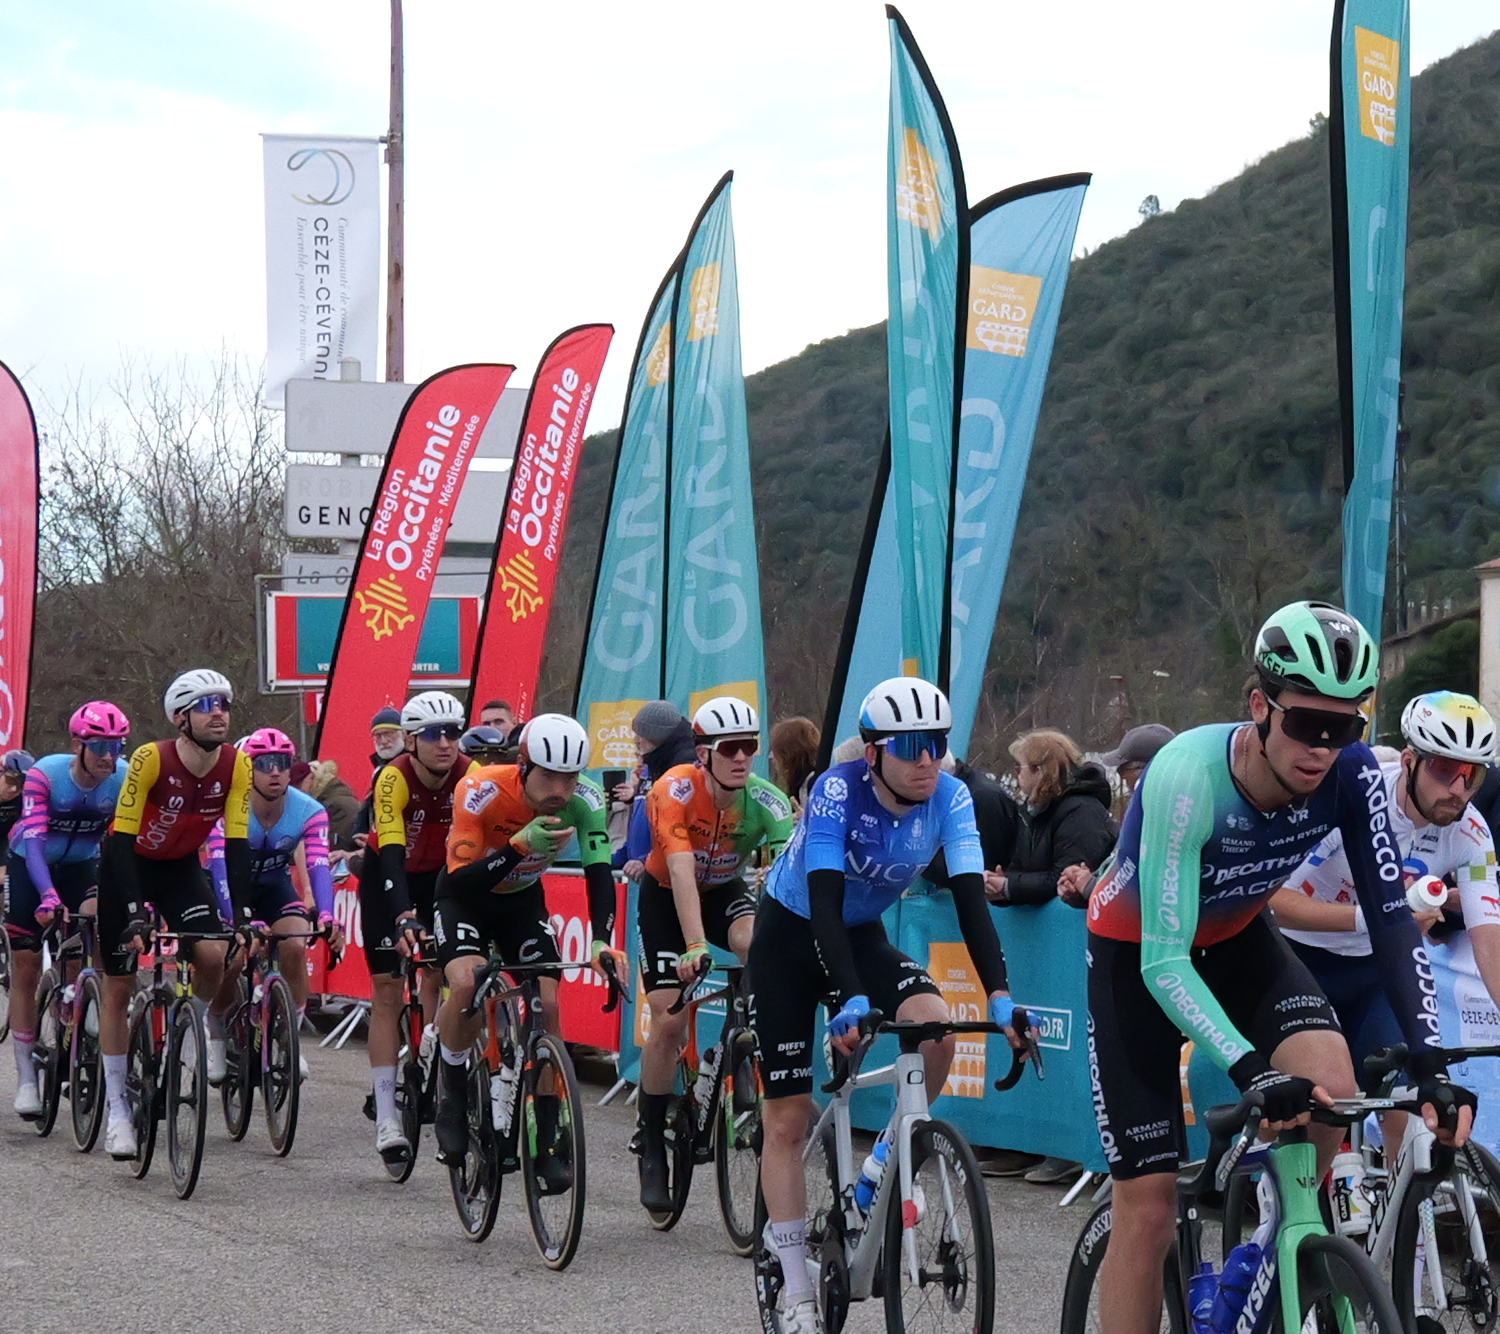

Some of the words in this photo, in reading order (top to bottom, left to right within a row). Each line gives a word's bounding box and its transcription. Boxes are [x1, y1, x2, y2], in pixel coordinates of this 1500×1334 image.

[972, 298, 1027, 323] GARD
[511, 432, 538, 509] Région
[520, 366, 580, 548] Occitanie
[543, 490, 566, 563] Pyrénées
[560, 380, 593, 481] Méditerranée
[365, 539, 383, 562] La
[375, 468, 406, 537] Région
[385, 404, 461, 571] Occitanie
[415, 514, 445, 581] Pyrénées
[440, 414, 481, 508] Méditerranée
[506, 513, 522, 535] La
[682, 380, 749, 655] GARD
[1259, 651, 1287, 677] YSEL
[597, 725, 637, 745] GAR
[120, 743, 154, 809] Cofidis
[377, 772, 398, 825] Cofidis
[136, 794, 185, 851] Cofidis
[1161, 793, 1195, 906] DECATHLON
[1220, 837, 1256, 848] ARMAND
[1268, 834, 1295, 848] VAN
[1296, 823, 1329, 840] RYSEL
[1356, 764, 1401, 883] Adecco
[1099, 855, 1138, 907] DECATHLON
[1214, 850, 1312, 886] DECATHL
[1170, 983, 1245, 1065] DECATHLON
[1273, 994, 1326, 1012] ARMAND
[1086, 1035, 1123, 1164] DECATHLON
[1124, 1119, 1171, 1137] ARMAND
[1131, 1127, 1171, 1143] THIERY
